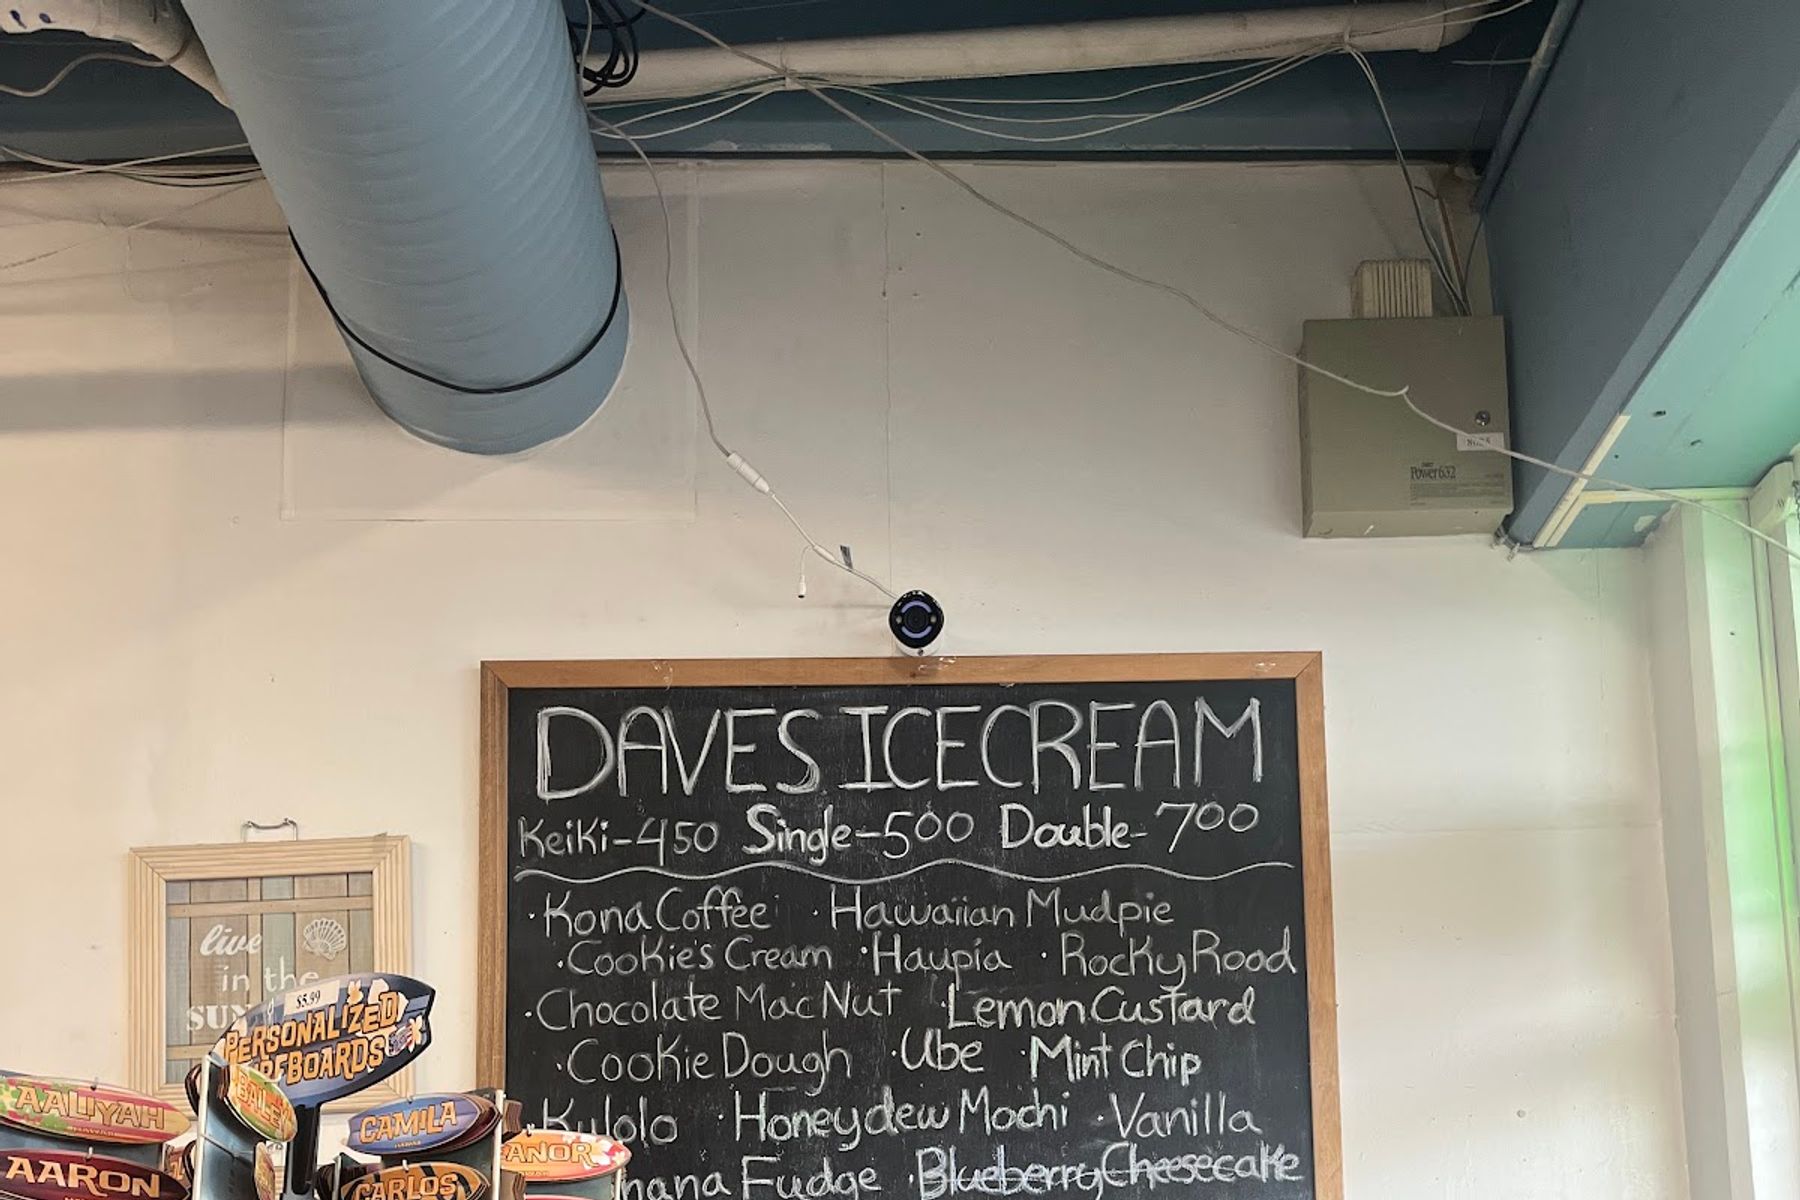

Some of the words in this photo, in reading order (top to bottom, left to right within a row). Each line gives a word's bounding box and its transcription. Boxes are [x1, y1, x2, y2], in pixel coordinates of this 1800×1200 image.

[656, 884, 773, 932] Coffee
[829, 884, 1015, 932] Hawaiian
[1026, 886, 1175, 938] Mudpie
[200, 923, 264, 957] live
[725, 935, 833, 971] Cream
[872, 930, 1013, 991] Haupia
[1192, 925, 1298, 976] Road
[221, 965, 250, 993] in
[263, 956, 320, 994] the
[296, 990, 321, 1009] $5.99
[223, 992, 399, 1063] PERSONALIZED
[536, 975, 722, 1031] Chocolate
[736, 982, 816, 1023] Mac
[821, 976, 903, 1020] Nut
[947, 983, 1087, 1030] Lemon
[1089, 984, 1257, 1030] Custard
[231, 1035, 386, 1086] RFBOARDS
[722, 1029, 853, 1097] Dough
[901, 1026, 985, 1074] Ube
[1031, 1032, 1112, 1083] Mint
[1122, 1034, 1203, 1087] Chip
[16, 1084, 166, 1131] AALIYAH
[359, 1100, 458, 1144] CAMILA
[735, 1084, 949, 1152] Honeydew
[959, 1084, 1072, 1136] Mochi
[1109, 1090, 1264, 1140] Vanilla
[5, 1155, 160, 1198] AARON
[500, 1142, 599, 1168] ANOR
[1101, 1141, 1304, 1191] Cheesecake
